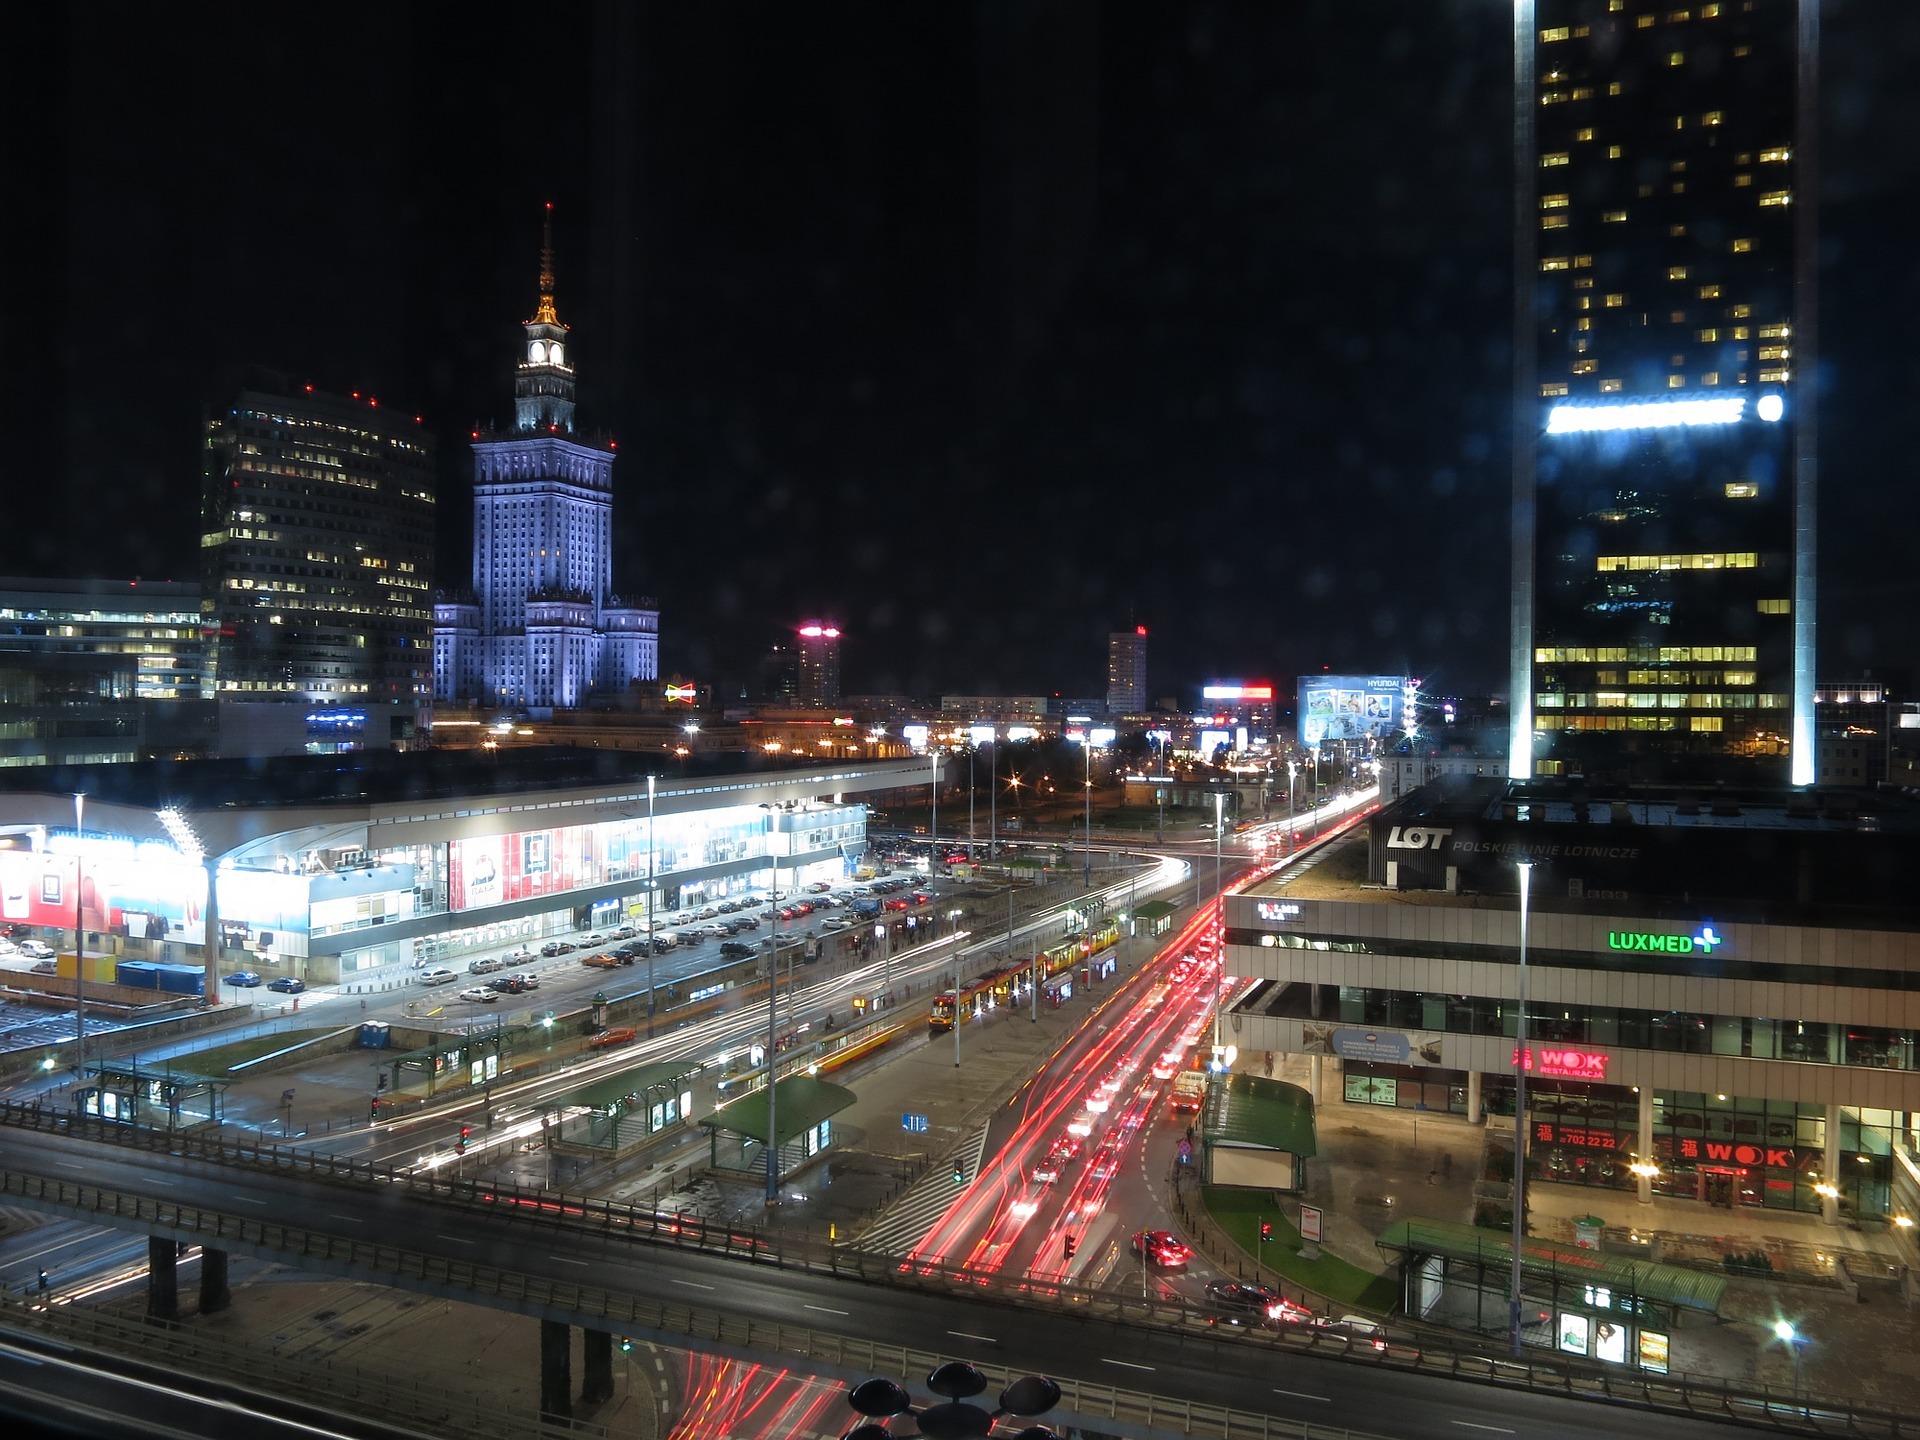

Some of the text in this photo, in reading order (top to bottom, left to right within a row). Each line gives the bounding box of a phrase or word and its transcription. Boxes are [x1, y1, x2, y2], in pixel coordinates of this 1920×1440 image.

[1387, 826, 1452, 850] LOT
[1453, 841, 1640, 859] POLSKIE LINIE LOTNICZE
[1608, 931, 1694, 953] LUXMED
[1541, 1051, 1604, 1070] WOK
[1540, 1066, 1604, 1078] RESTAURACJA
[1567, 1134, 1585, 1145] 702
[1587, 1137, 1600, 1147] 22
[1602, 1138, 1616, 1149] 22
[1681, 1139, 1697, 1157] 福
[1706, 1143, 1788, 1167] WOK
